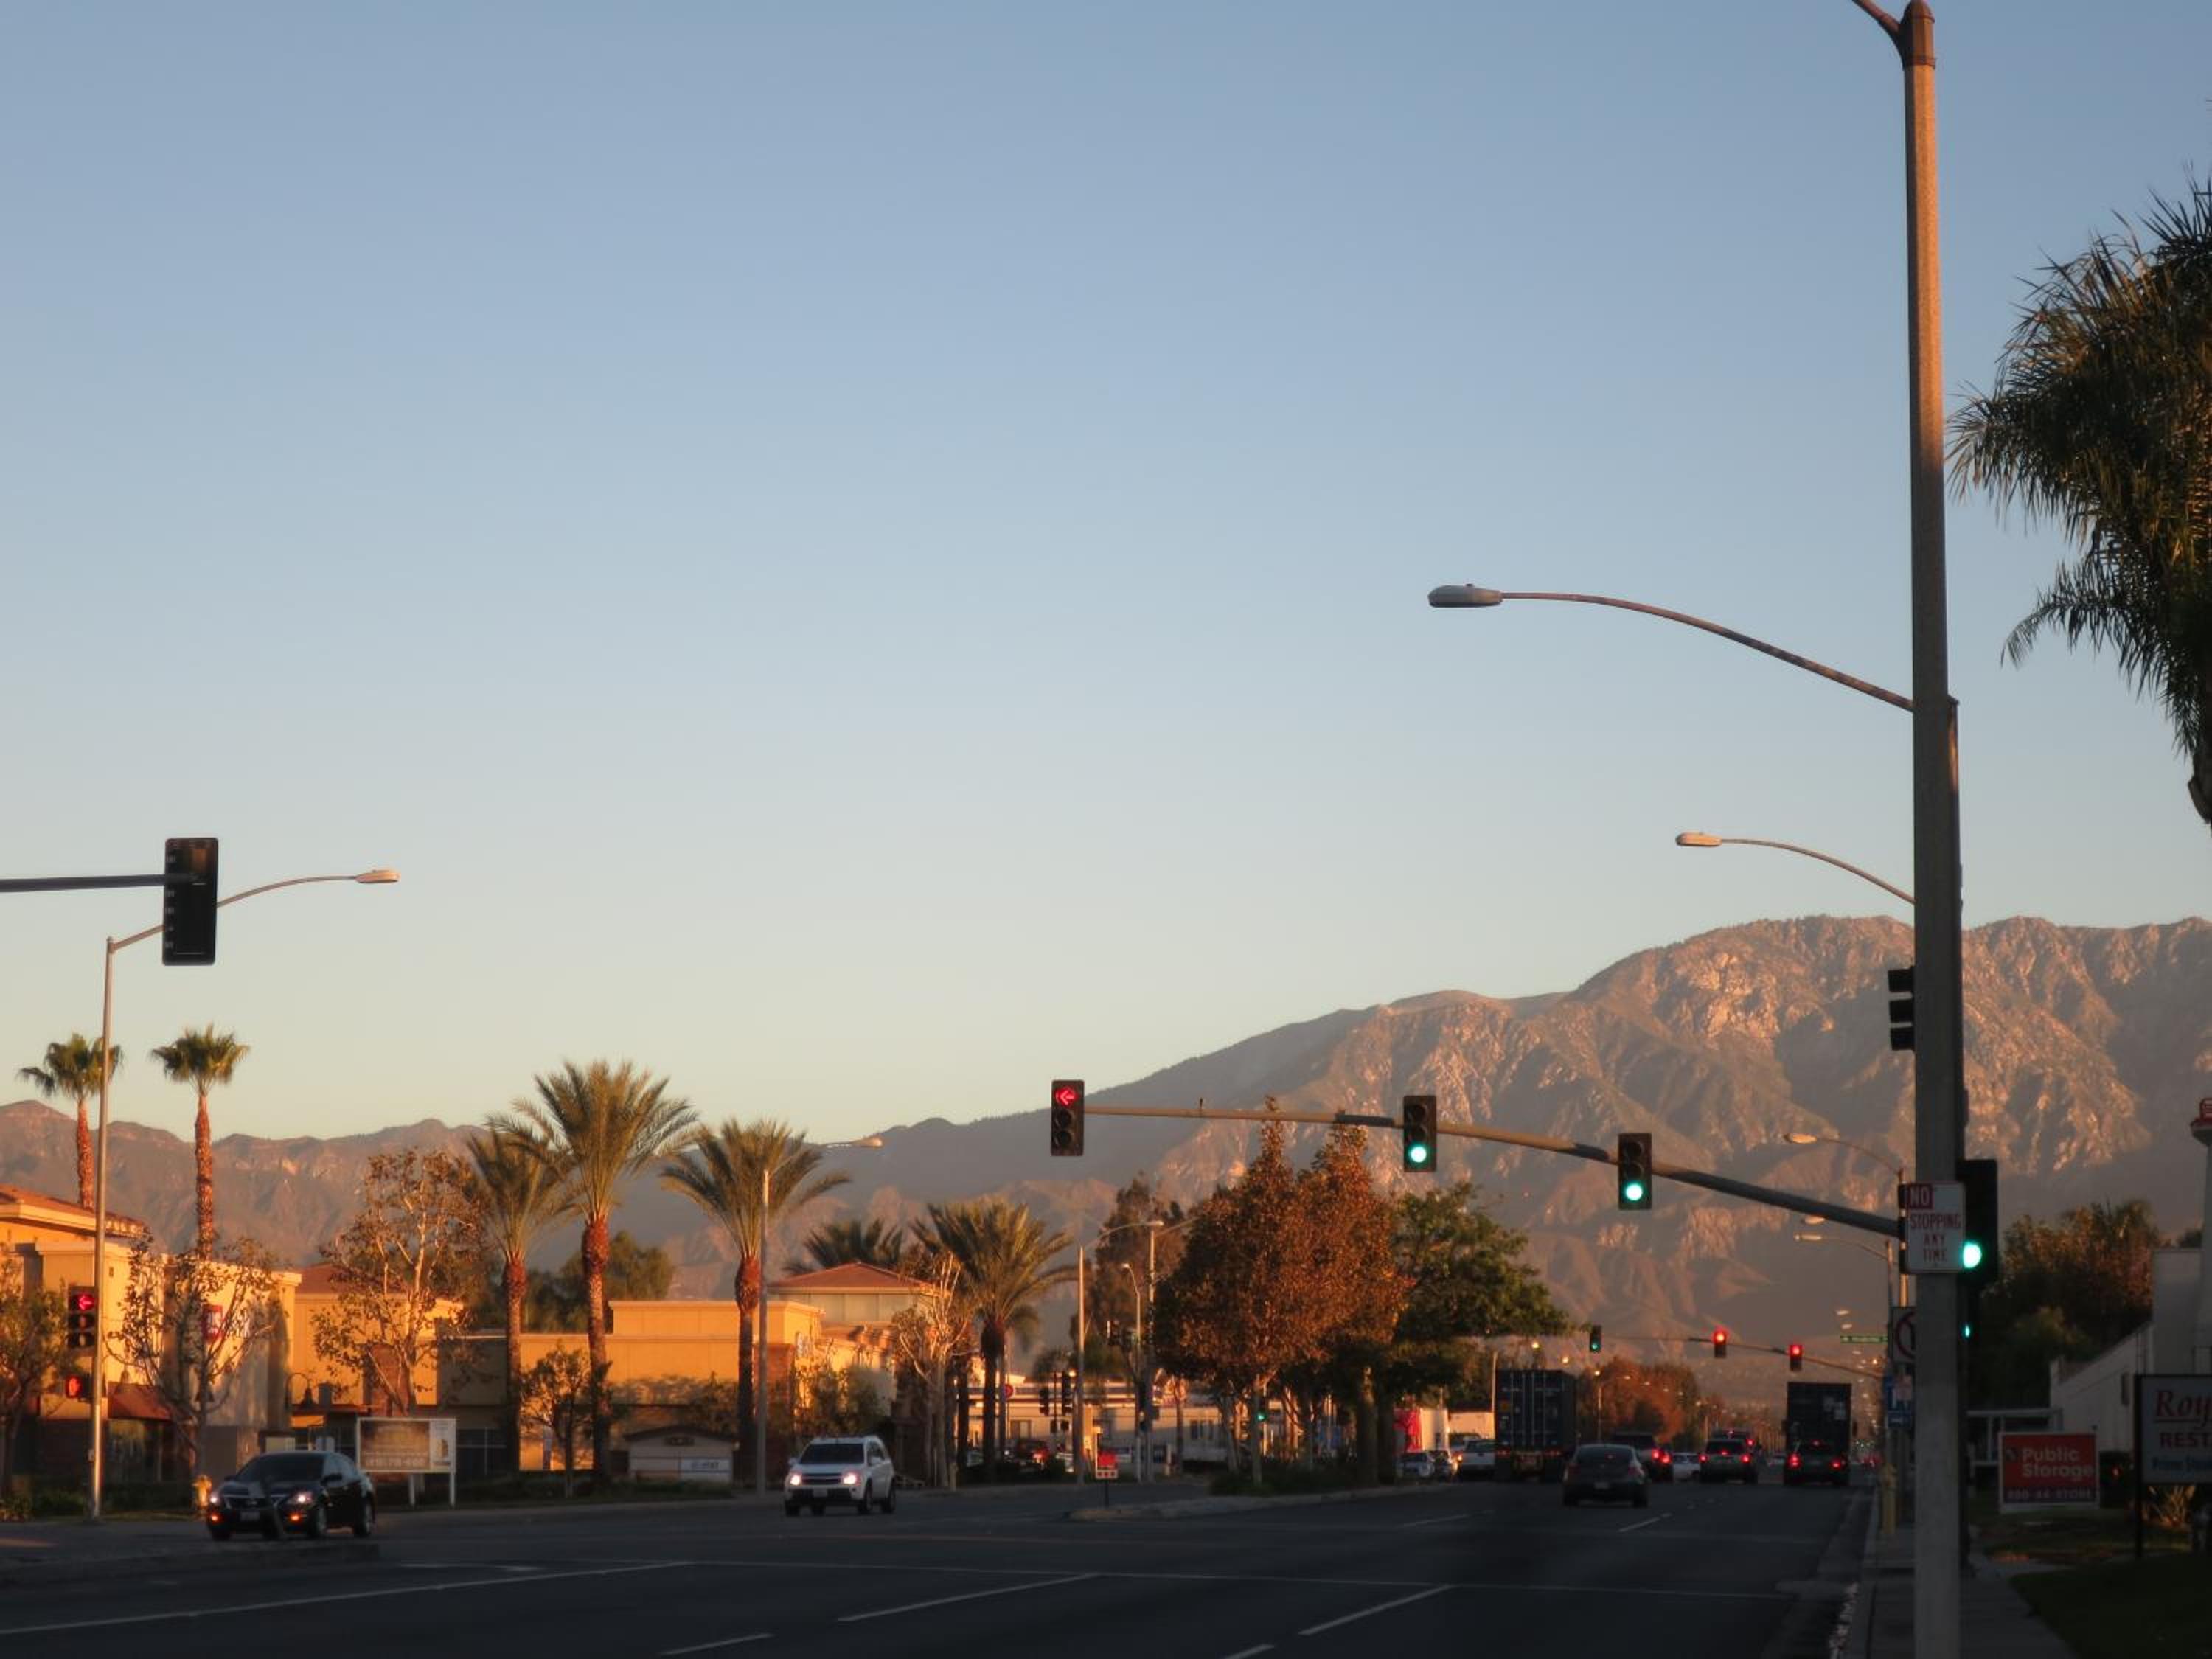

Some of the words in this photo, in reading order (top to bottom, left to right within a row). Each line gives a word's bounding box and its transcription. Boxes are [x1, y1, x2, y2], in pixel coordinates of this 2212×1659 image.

[1910, 1186, 1930, 1206] NO
[1910, 1214, 1961, 1228] STOPPING
[1922, 1233, 1946, 1246] ANY
[1922, 1248, 1948, 1262] TIME
[2022, 1446, 2081, 1462] Public
[2022, 1463, 2094, 1481] Storage
